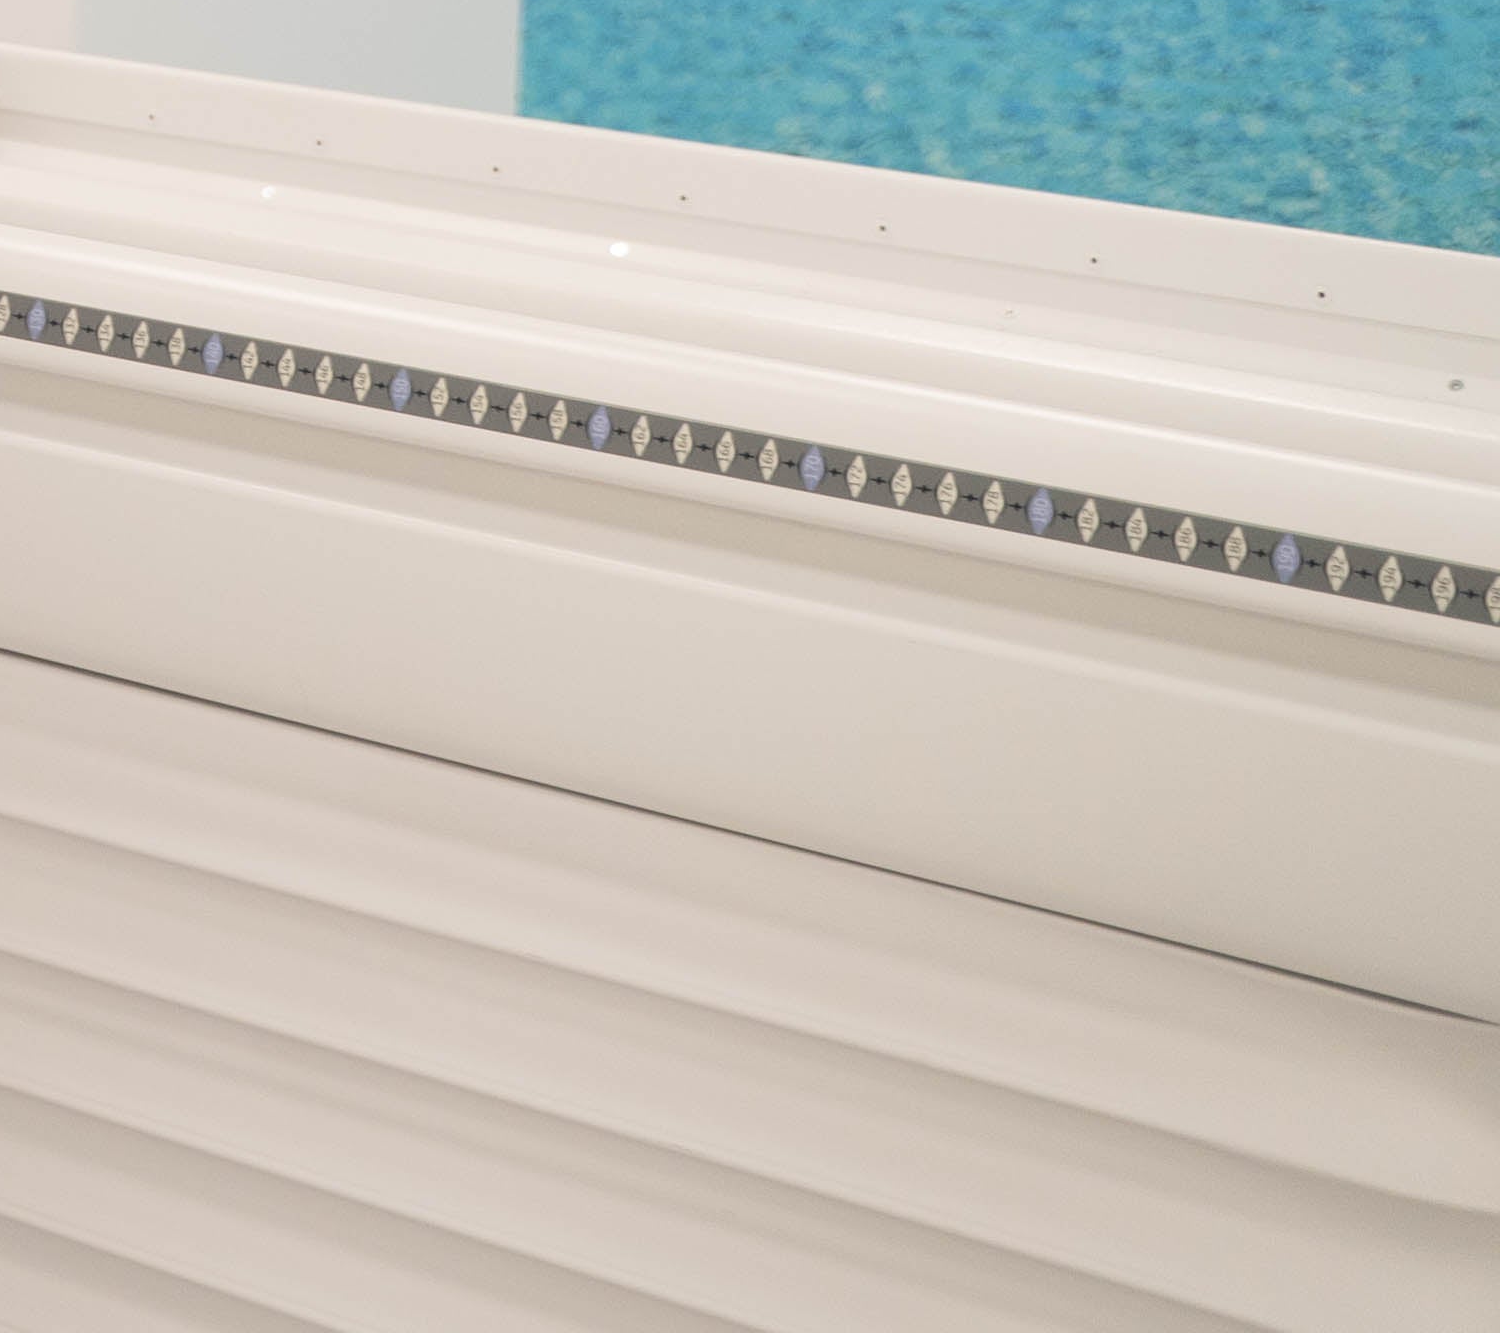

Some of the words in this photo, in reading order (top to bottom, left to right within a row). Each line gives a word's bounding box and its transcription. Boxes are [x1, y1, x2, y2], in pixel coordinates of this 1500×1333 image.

[242, 350, 253, 370] 142
[279, 357, 290, 377] 144
[317, 364, 327, 384] 146
[355, 371, 365, 391] 148
[432, 386, 443, 406] 152
[471, 393, 482, 414] 154
[511, 401, 522, 421] 156
[551, 409, 563, 429] 158
[634, 424, 645, 445] 162
[676, 432, 688, 453] 164
[719, 440, 730, 461] 166
[762, 448, 774, 470] 168
[850, 465, 862, 487] 172
[895, 474, 907, 495] 174
[941, 482, 953, 504] 176
[987, 491, 1000, 513] 178
[1081, 509, 1094, 531] 182
[1130, 518, 1143, 541] 184
[1179, 527, 1192, 550] 186
[1228, 537, 1242, 560] 188
[1330, 556, 1343, 579] 192
[1381, 566, 1395, 589] 194
[1434, 576, 1448, 599] 196
